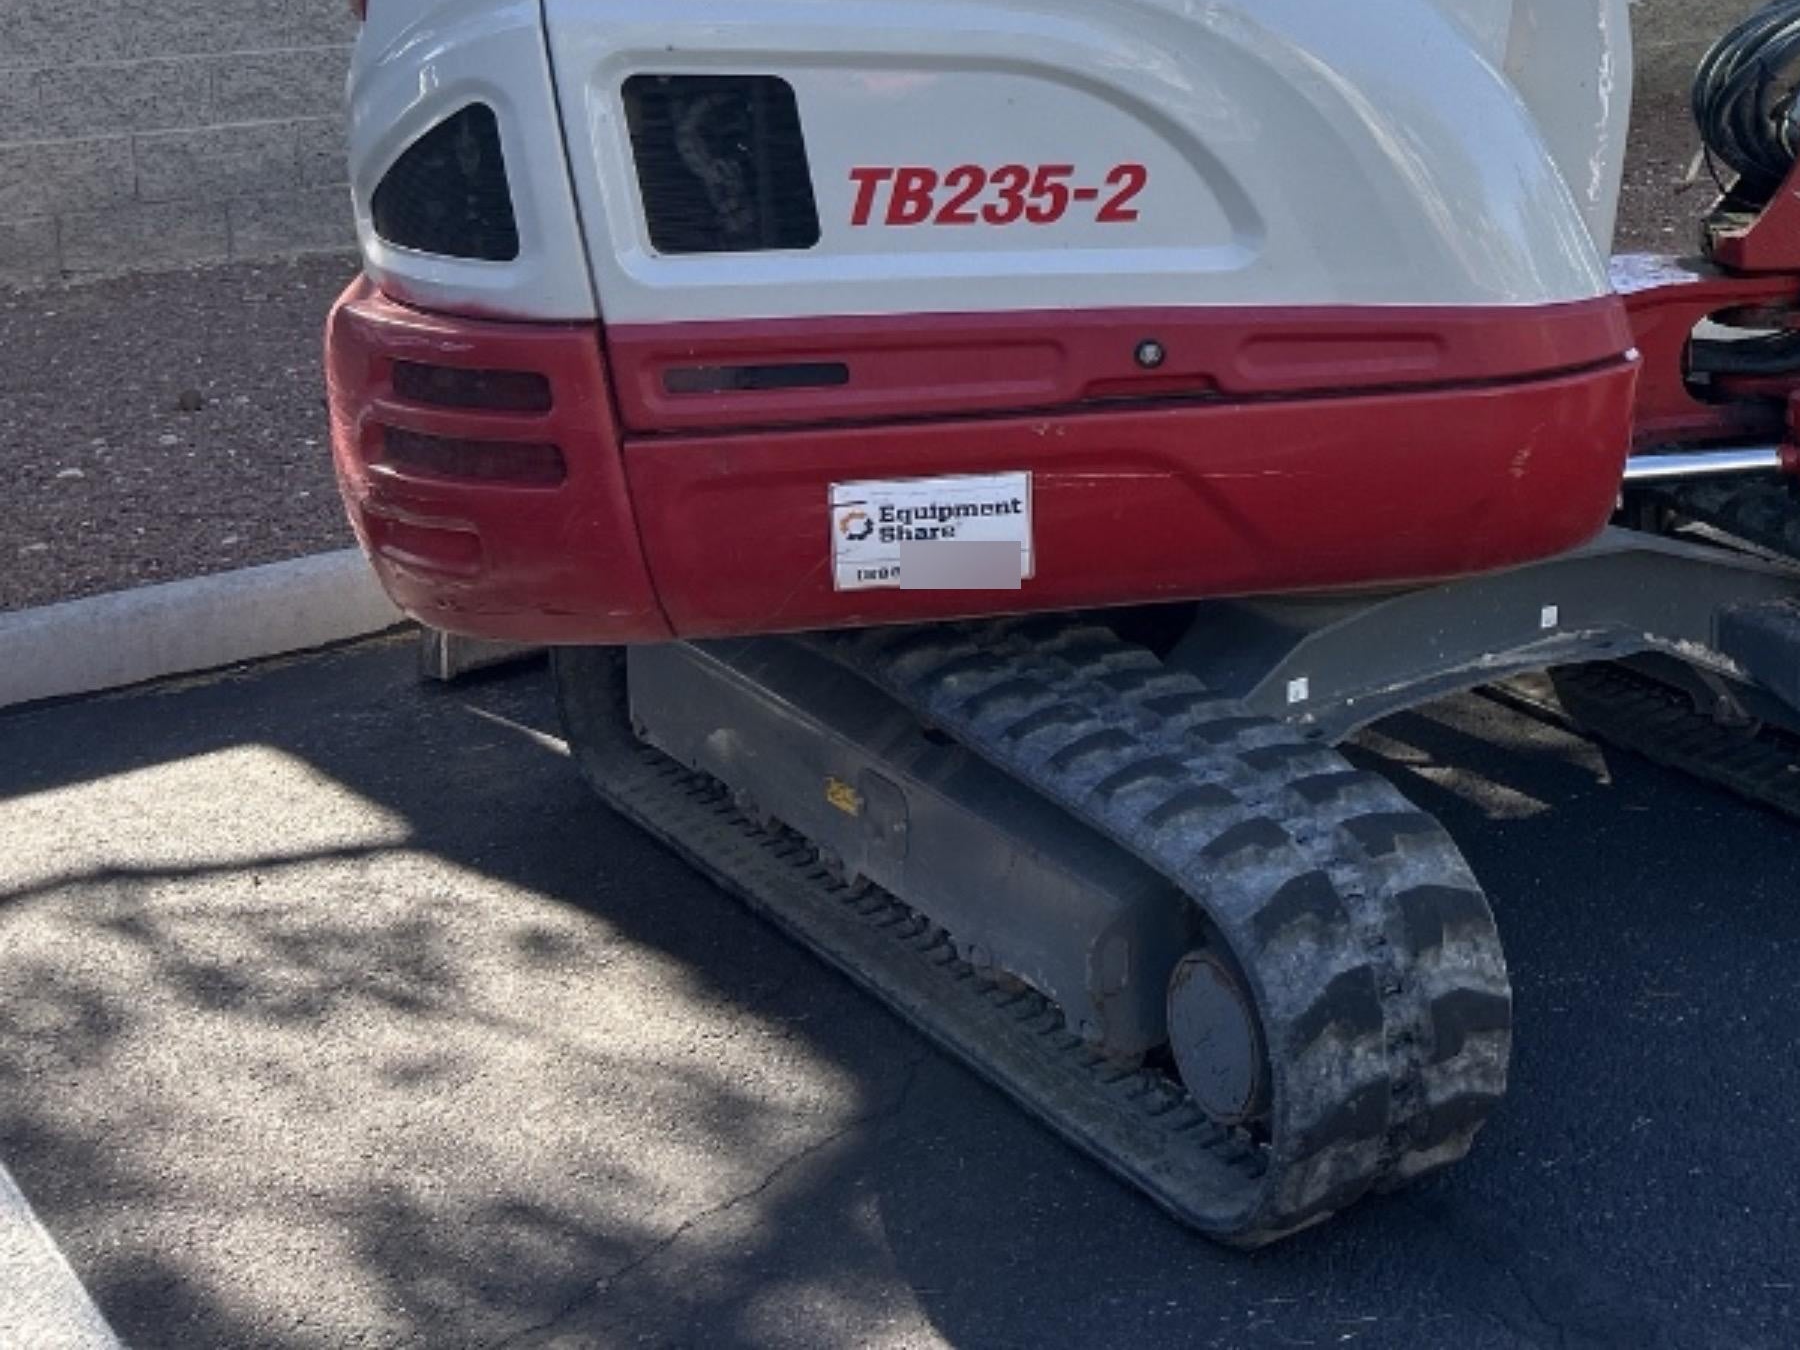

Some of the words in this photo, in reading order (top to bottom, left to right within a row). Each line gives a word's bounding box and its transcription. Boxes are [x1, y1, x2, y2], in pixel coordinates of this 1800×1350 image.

[847, 163, 1148, 227] TB235-2
[878, 496, 1023, 524] Equipment
[878, 523, 957, 543] Share
